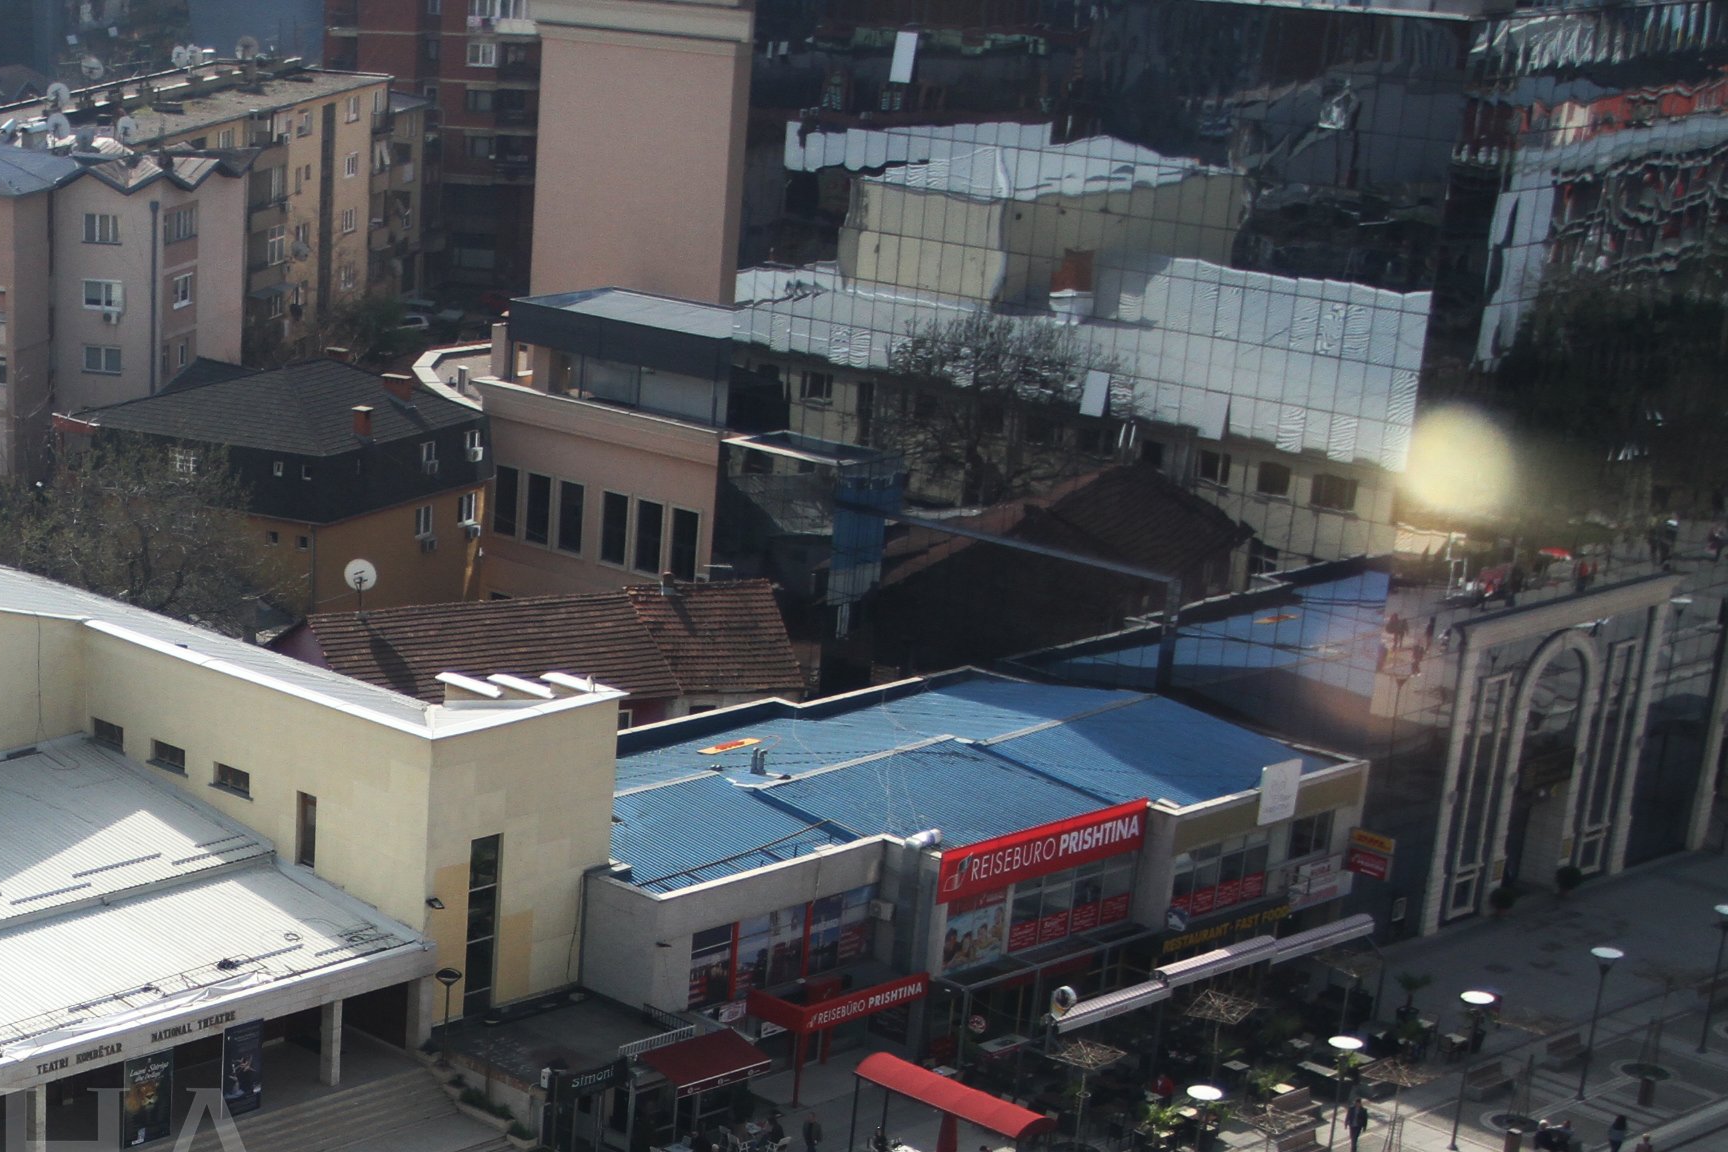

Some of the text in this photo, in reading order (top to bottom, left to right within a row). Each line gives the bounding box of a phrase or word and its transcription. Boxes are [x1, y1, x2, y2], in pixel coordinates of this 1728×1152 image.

[1059, 815, 1139, 857] PRISHTINA
[1162, 922, 1229, 954] RESTAURANT
[1235, 913, 1262, 931] FAST
[817, 982, 922, 1024] REISEBÜRO PRISHTINA
[151, 1022, 193, 1043] NATIONAL
[197, 1010, 236, 1030] THEATRE
[36, 1057, 69, 1075] TEATRI
[572, 1065, 614, 1088] simoni
